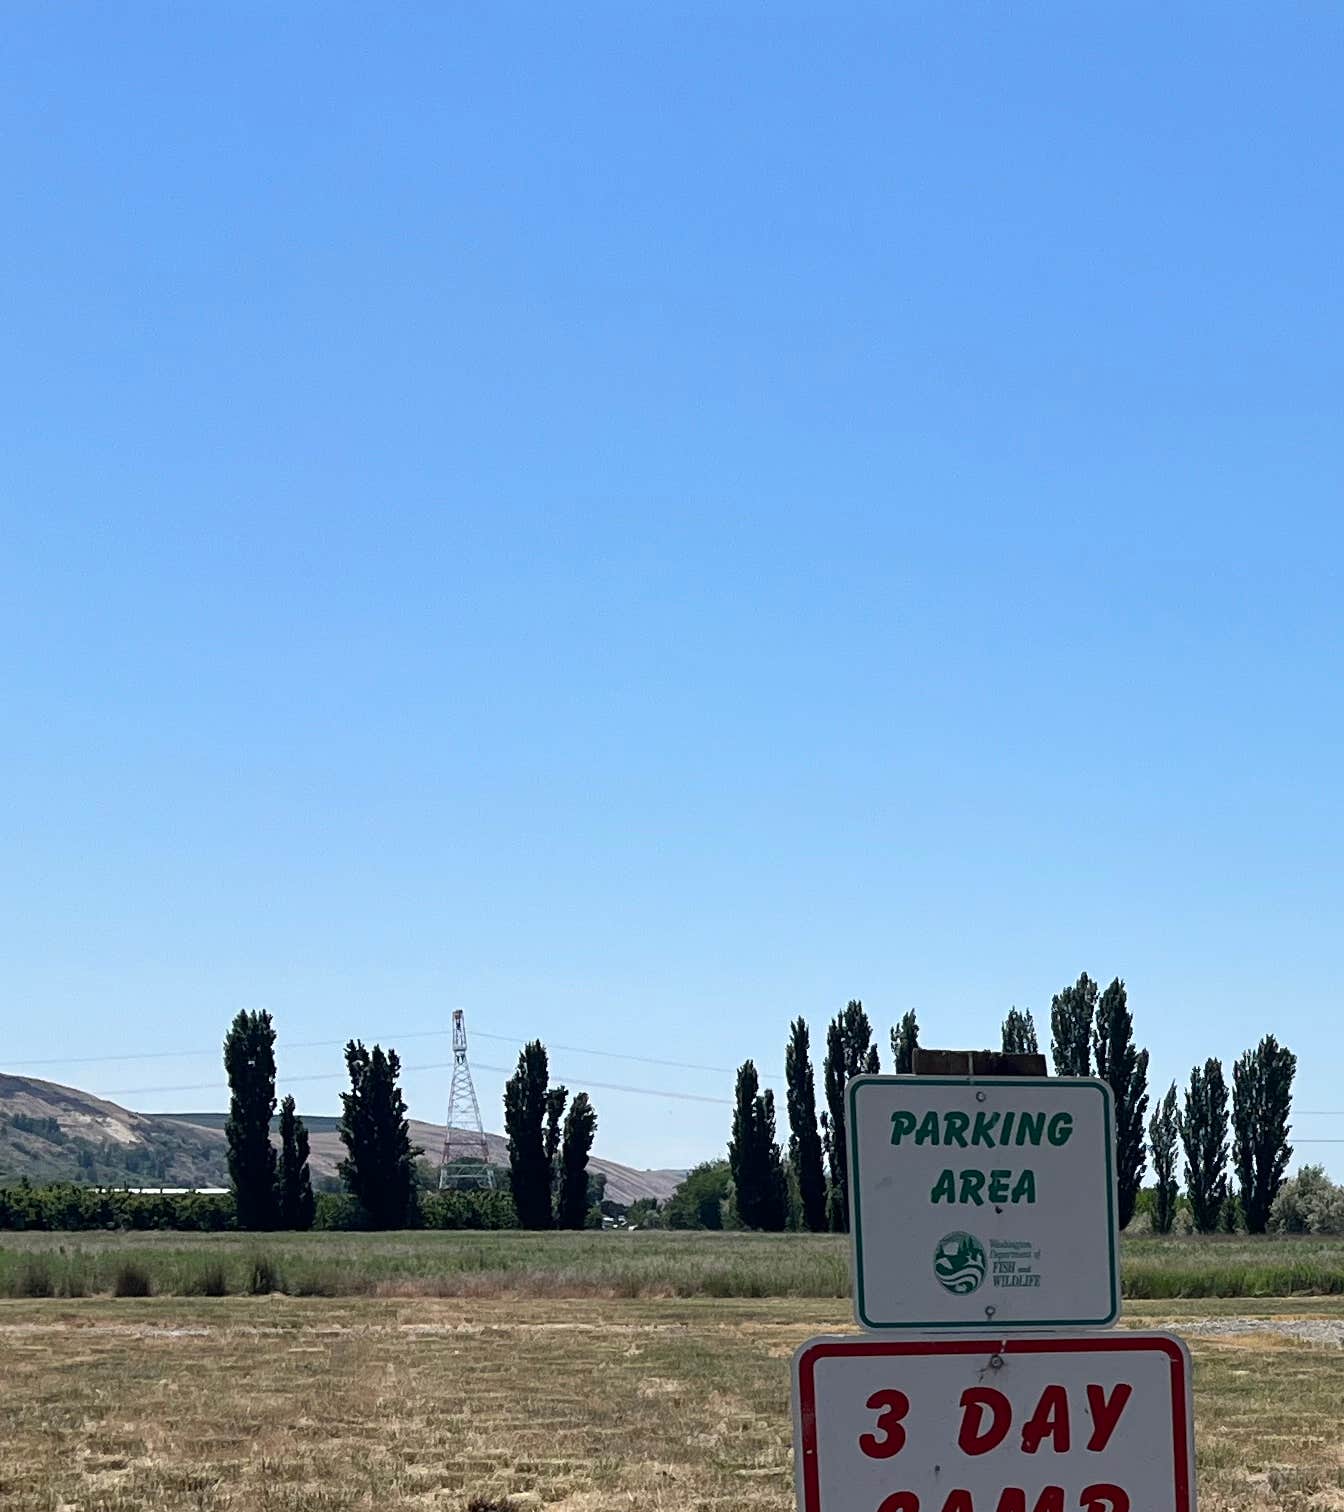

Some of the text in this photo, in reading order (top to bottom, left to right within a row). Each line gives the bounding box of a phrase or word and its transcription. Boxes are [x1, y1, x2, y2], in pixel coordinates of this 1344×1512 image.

[890, 1111, 1073, 1149] PARKING
[930, 1169, 1036, 1206] AREA
[993, 1262, 1016, 1273] FISH
[993, 1275, 1040, 1287] WILDLIFE
[859, 1383, 1132, 1459] 3 DAY
